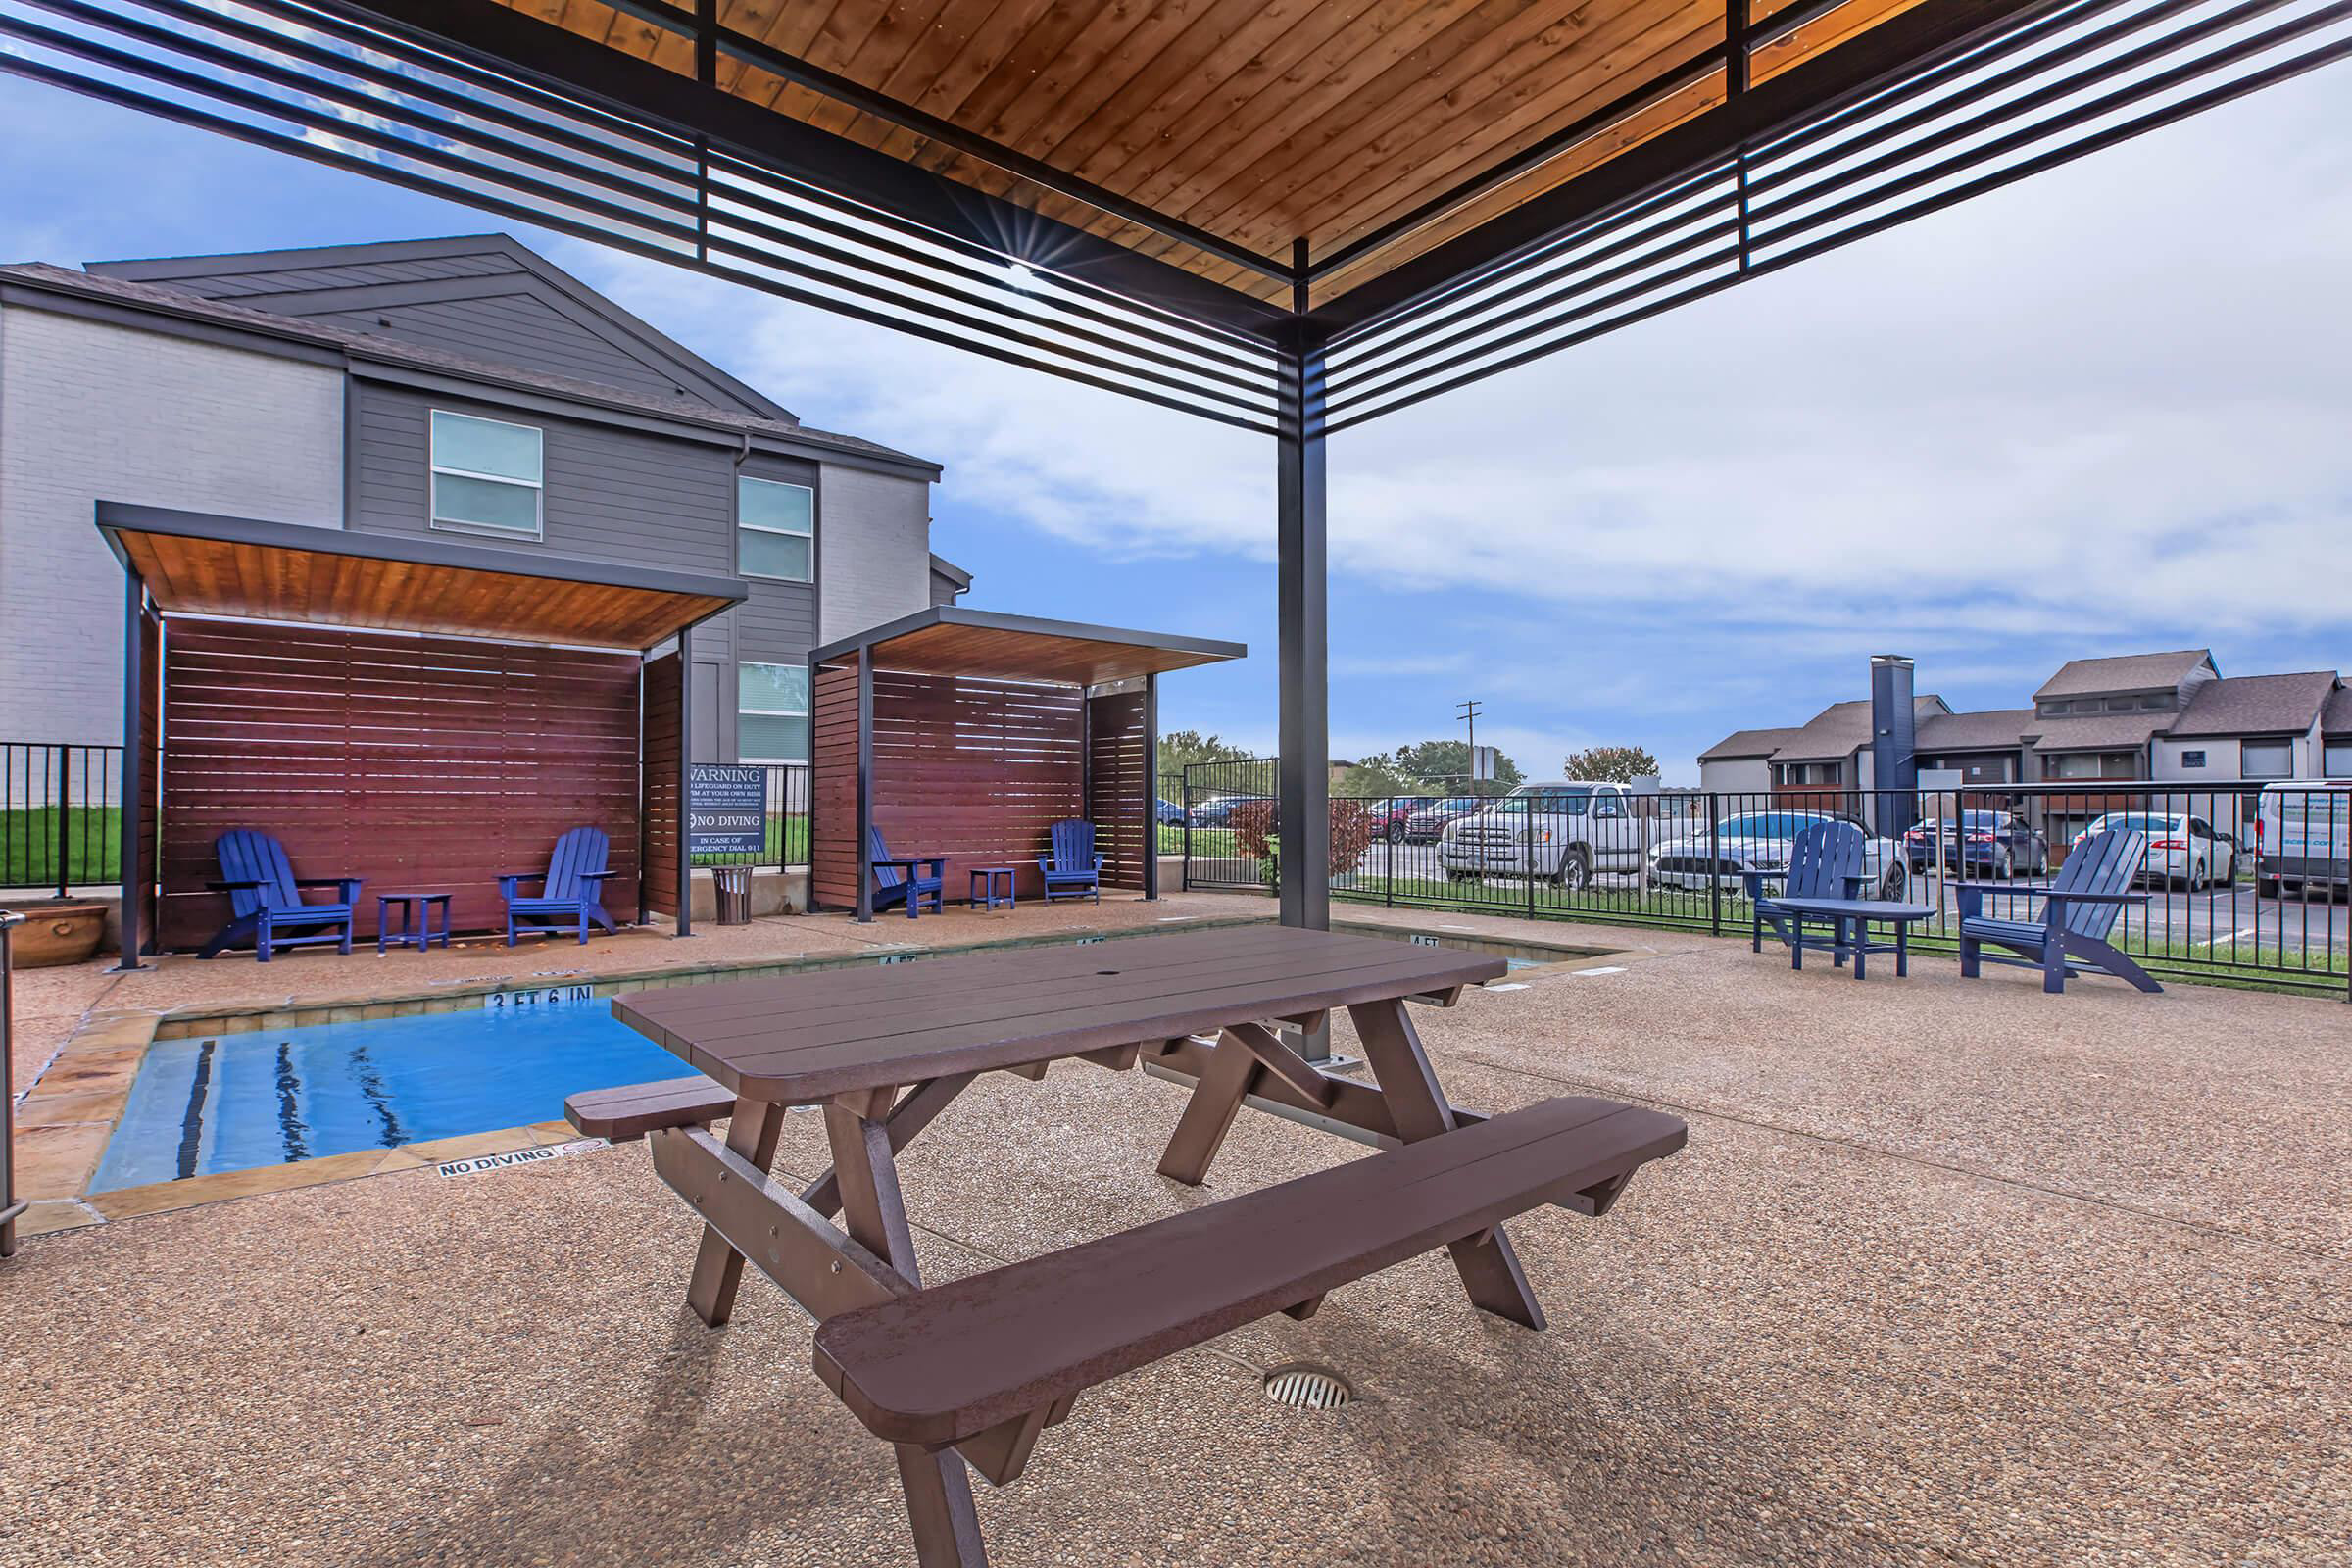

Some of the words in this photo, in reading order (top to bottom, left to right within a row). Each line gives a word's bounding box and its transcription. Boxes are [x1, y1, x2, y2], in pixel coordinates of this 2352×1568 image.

[698, 815, 715, 826] NO
[718, 815, 760, 826] DIVING
[514, 991, 539, 1005] FT
[548, 989, 559, 1003] 6
[570, 986, 591, 1001] IN
[440, 1162, 470, 1176] NO
[474, 1150, 554, 1169] DIVING
